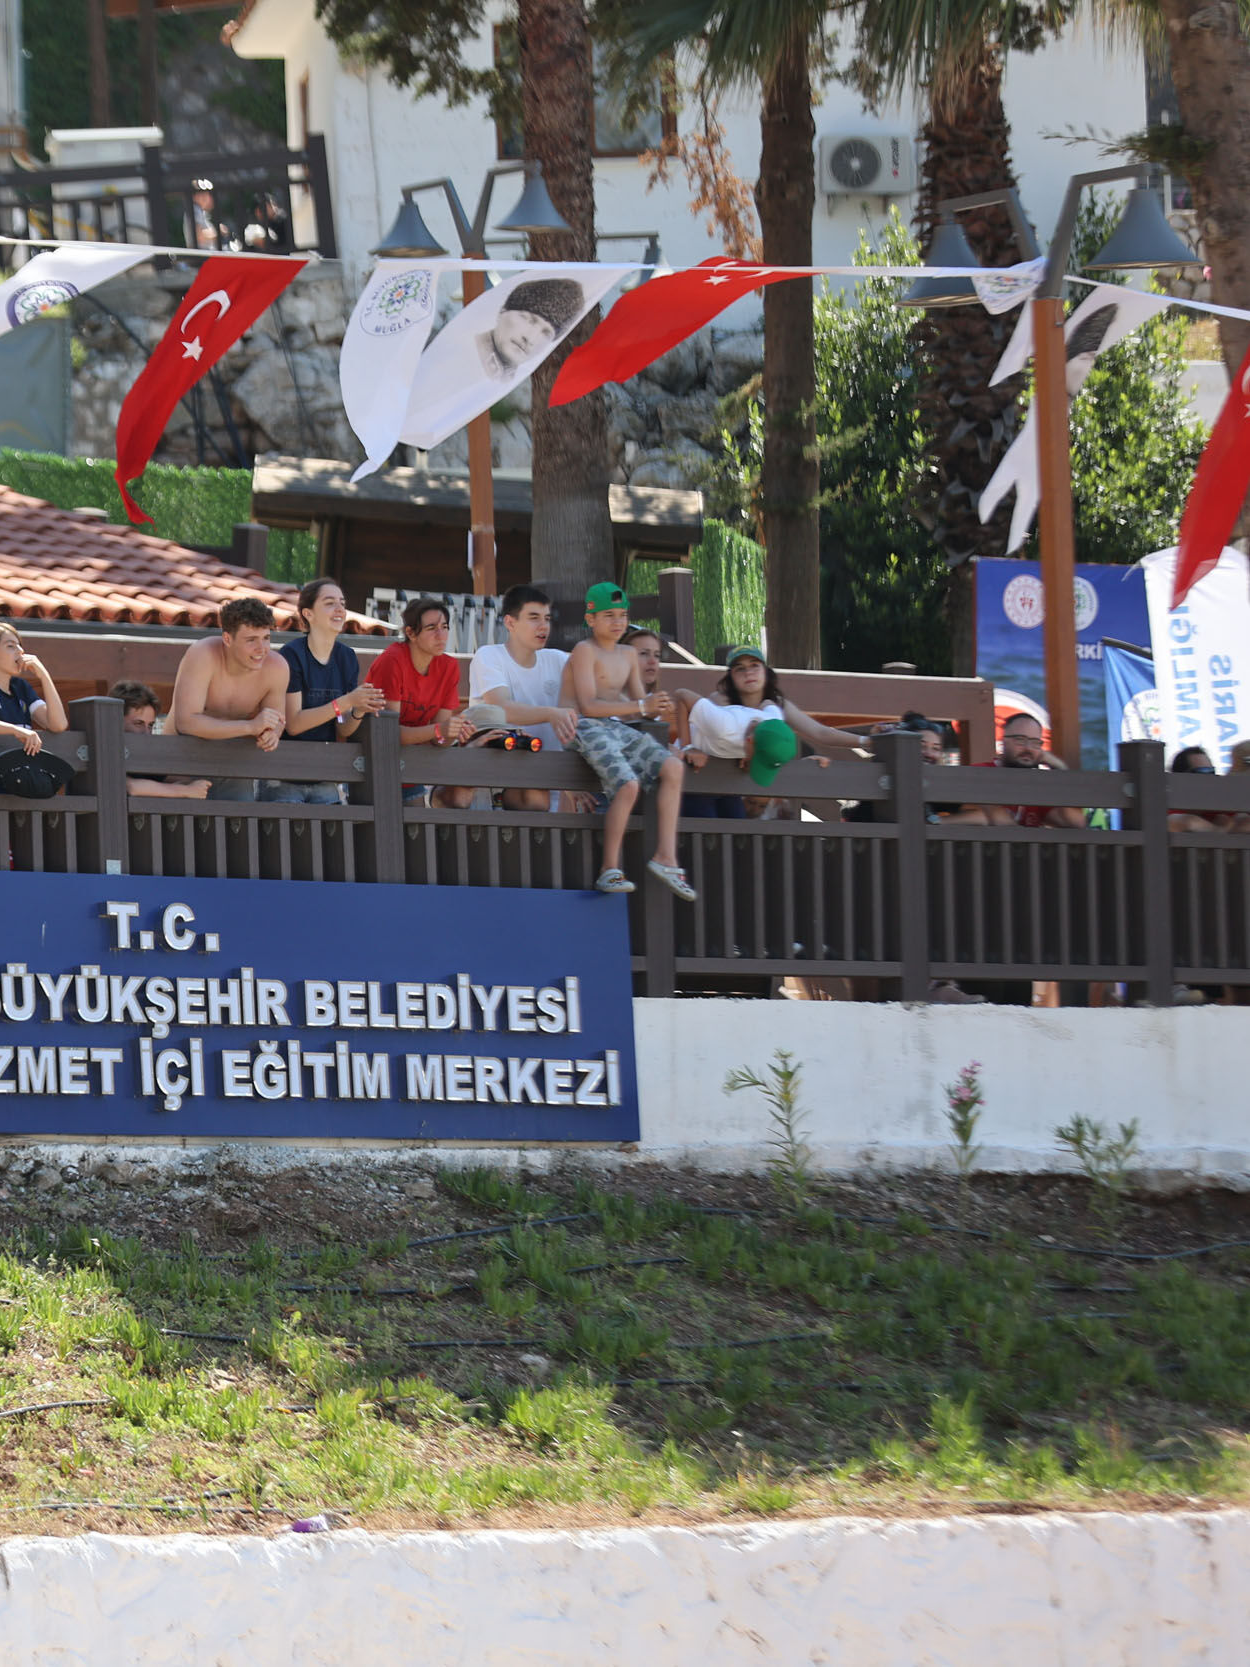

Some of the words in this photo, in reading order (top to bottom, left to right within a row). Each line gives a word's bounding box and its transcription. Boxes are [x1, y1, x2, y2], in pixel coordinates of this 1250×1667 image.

[106, 900, 220, 953] T.C.
[303, 973, 582, 1034] BELEDİYESİ
[138, 1037, 206, 1112] İÇİ
[220, 1039, 392, 1101] EĞİTİM
[404, 1049, 622, 1107] MERKEZİ
